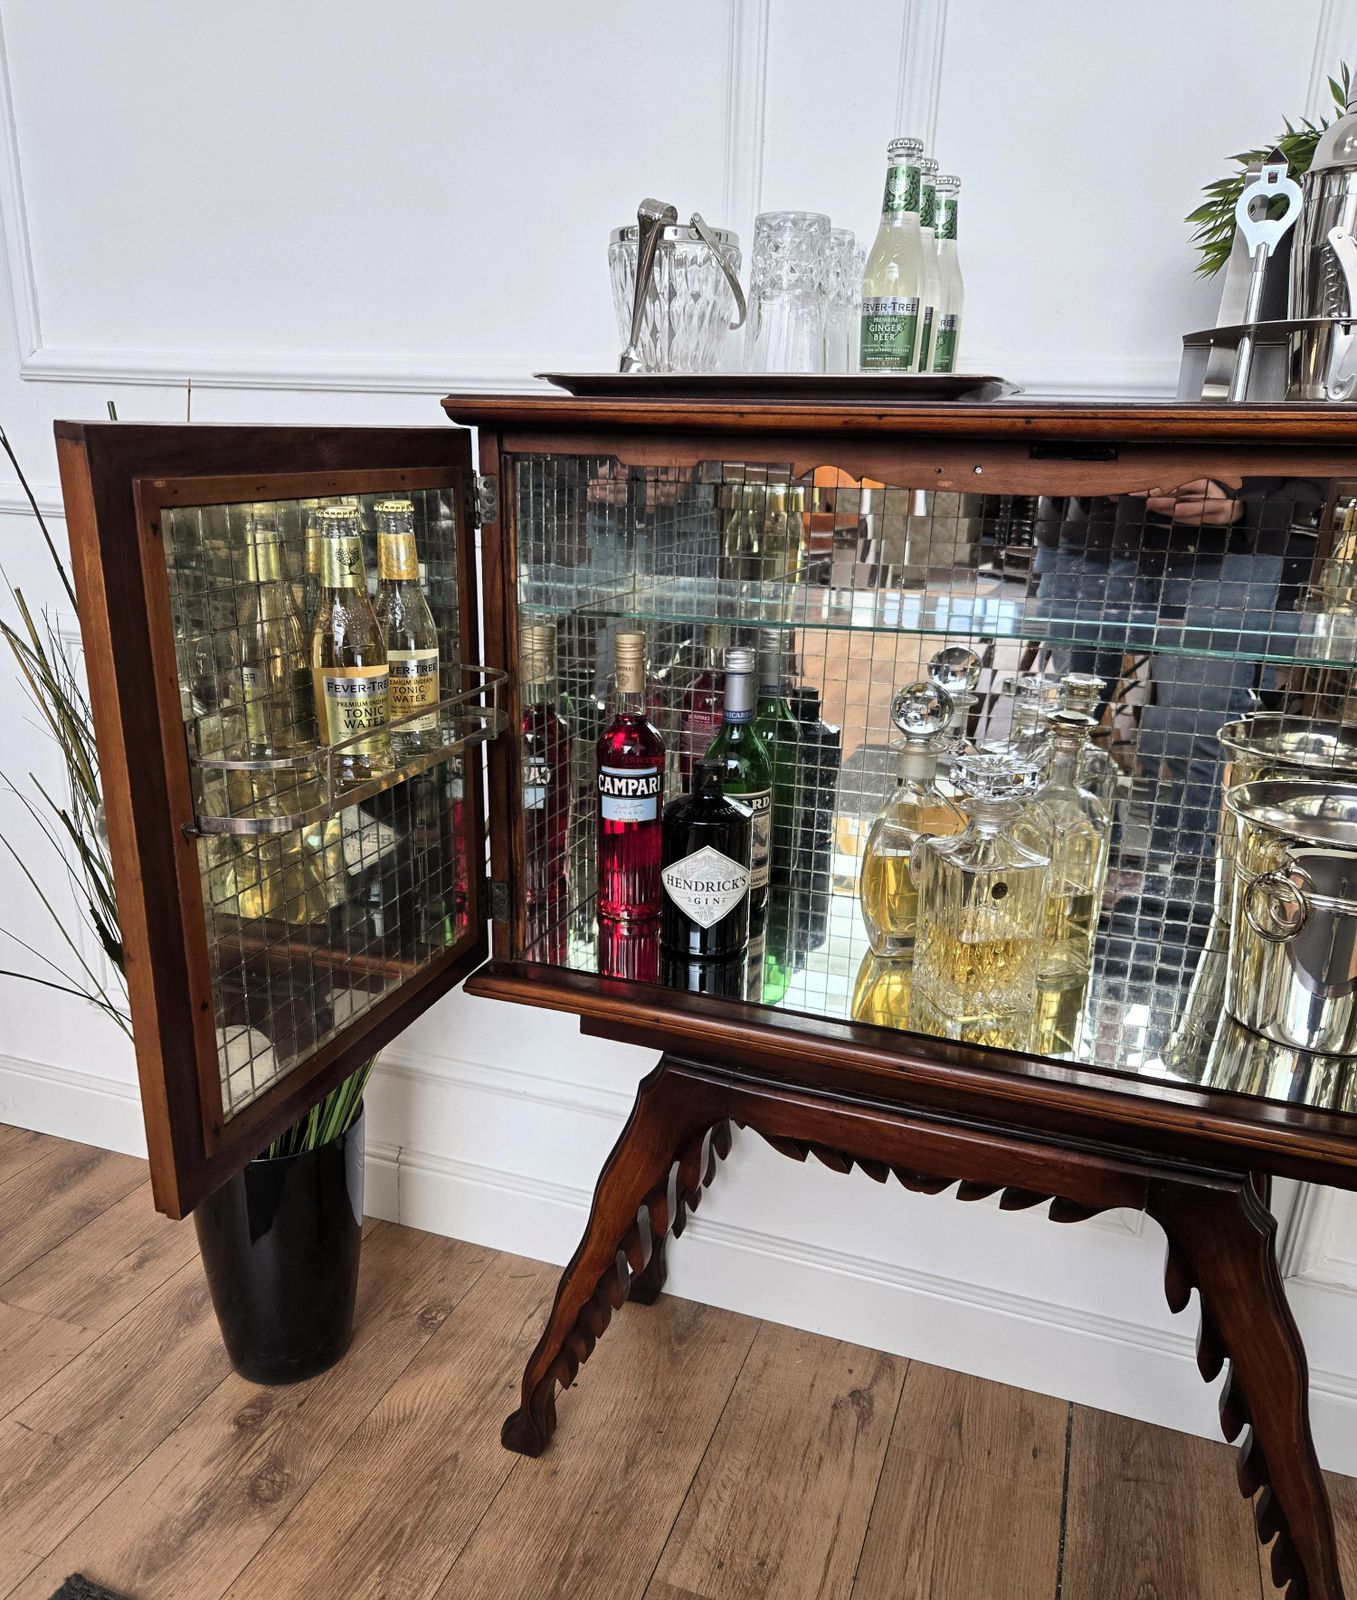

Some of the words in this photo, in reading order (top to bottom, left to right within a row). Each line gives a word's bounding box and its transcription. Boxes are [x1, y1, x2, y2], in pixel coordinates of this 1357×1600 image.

[862, 301, 916, 312] FEVER-TREE
[869, 324, 903, 332] GINGER
[873, 333, 895, 341] BEER
[393, 685, 425, 694] TONIC
[392, 694, 426, 702] WATER
[344, 705, 384, 718] TONIC
[344, 717, 385, 729] WATER
[598, 774, 661, 796] CAMPARI
[666, 873, 747, 893] HENDRICK'S
[694, 897, 720, 905] GIN
